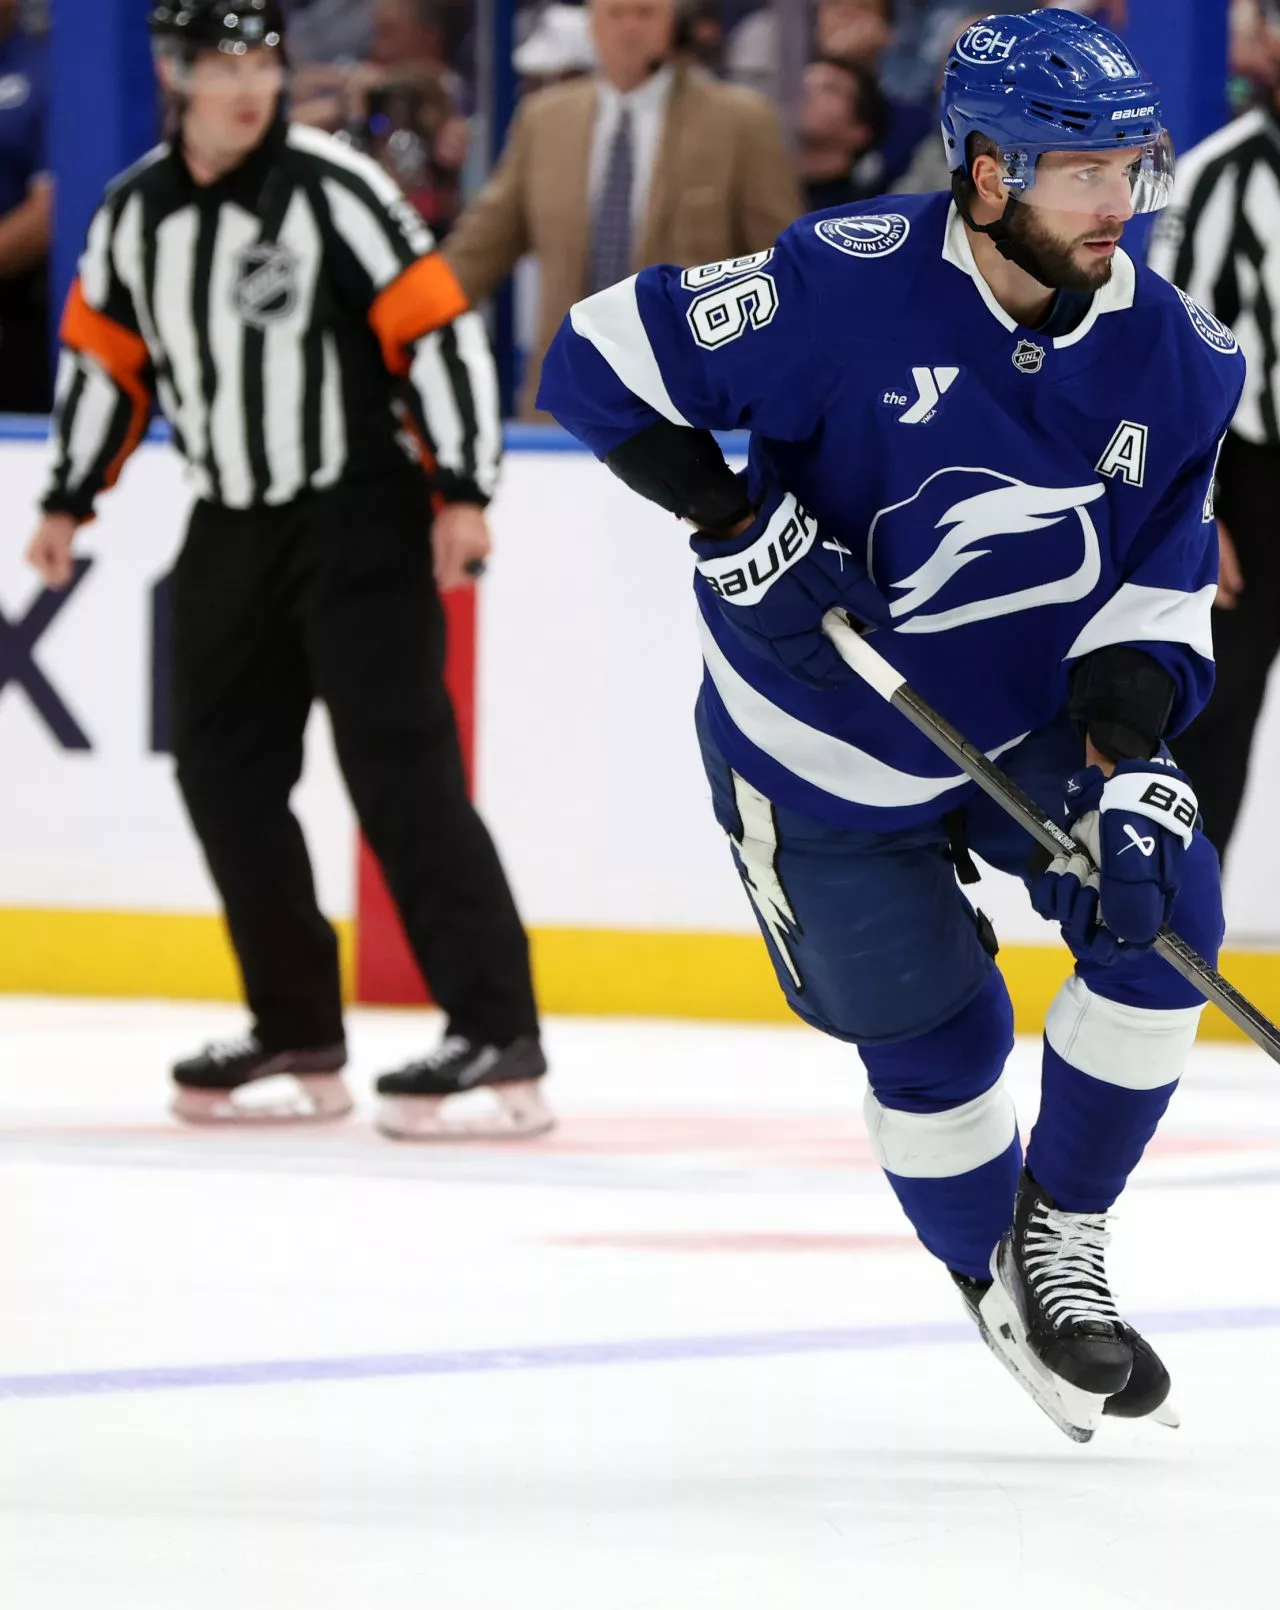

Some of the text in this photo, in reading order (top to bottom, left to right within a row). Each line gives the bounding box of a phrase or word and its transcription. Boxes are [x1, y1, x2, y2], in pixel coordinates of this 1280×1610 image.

[843, 223, 904, 252] LIGHTNING
[1018, 352, 1038, 363] NHL
[883, 391, 908, 406] the
[920, 409, 938, 425] YMCA
[1094, 419, 1149, 488] A
[1042, 819, 1077, 850] KUCHEROV
